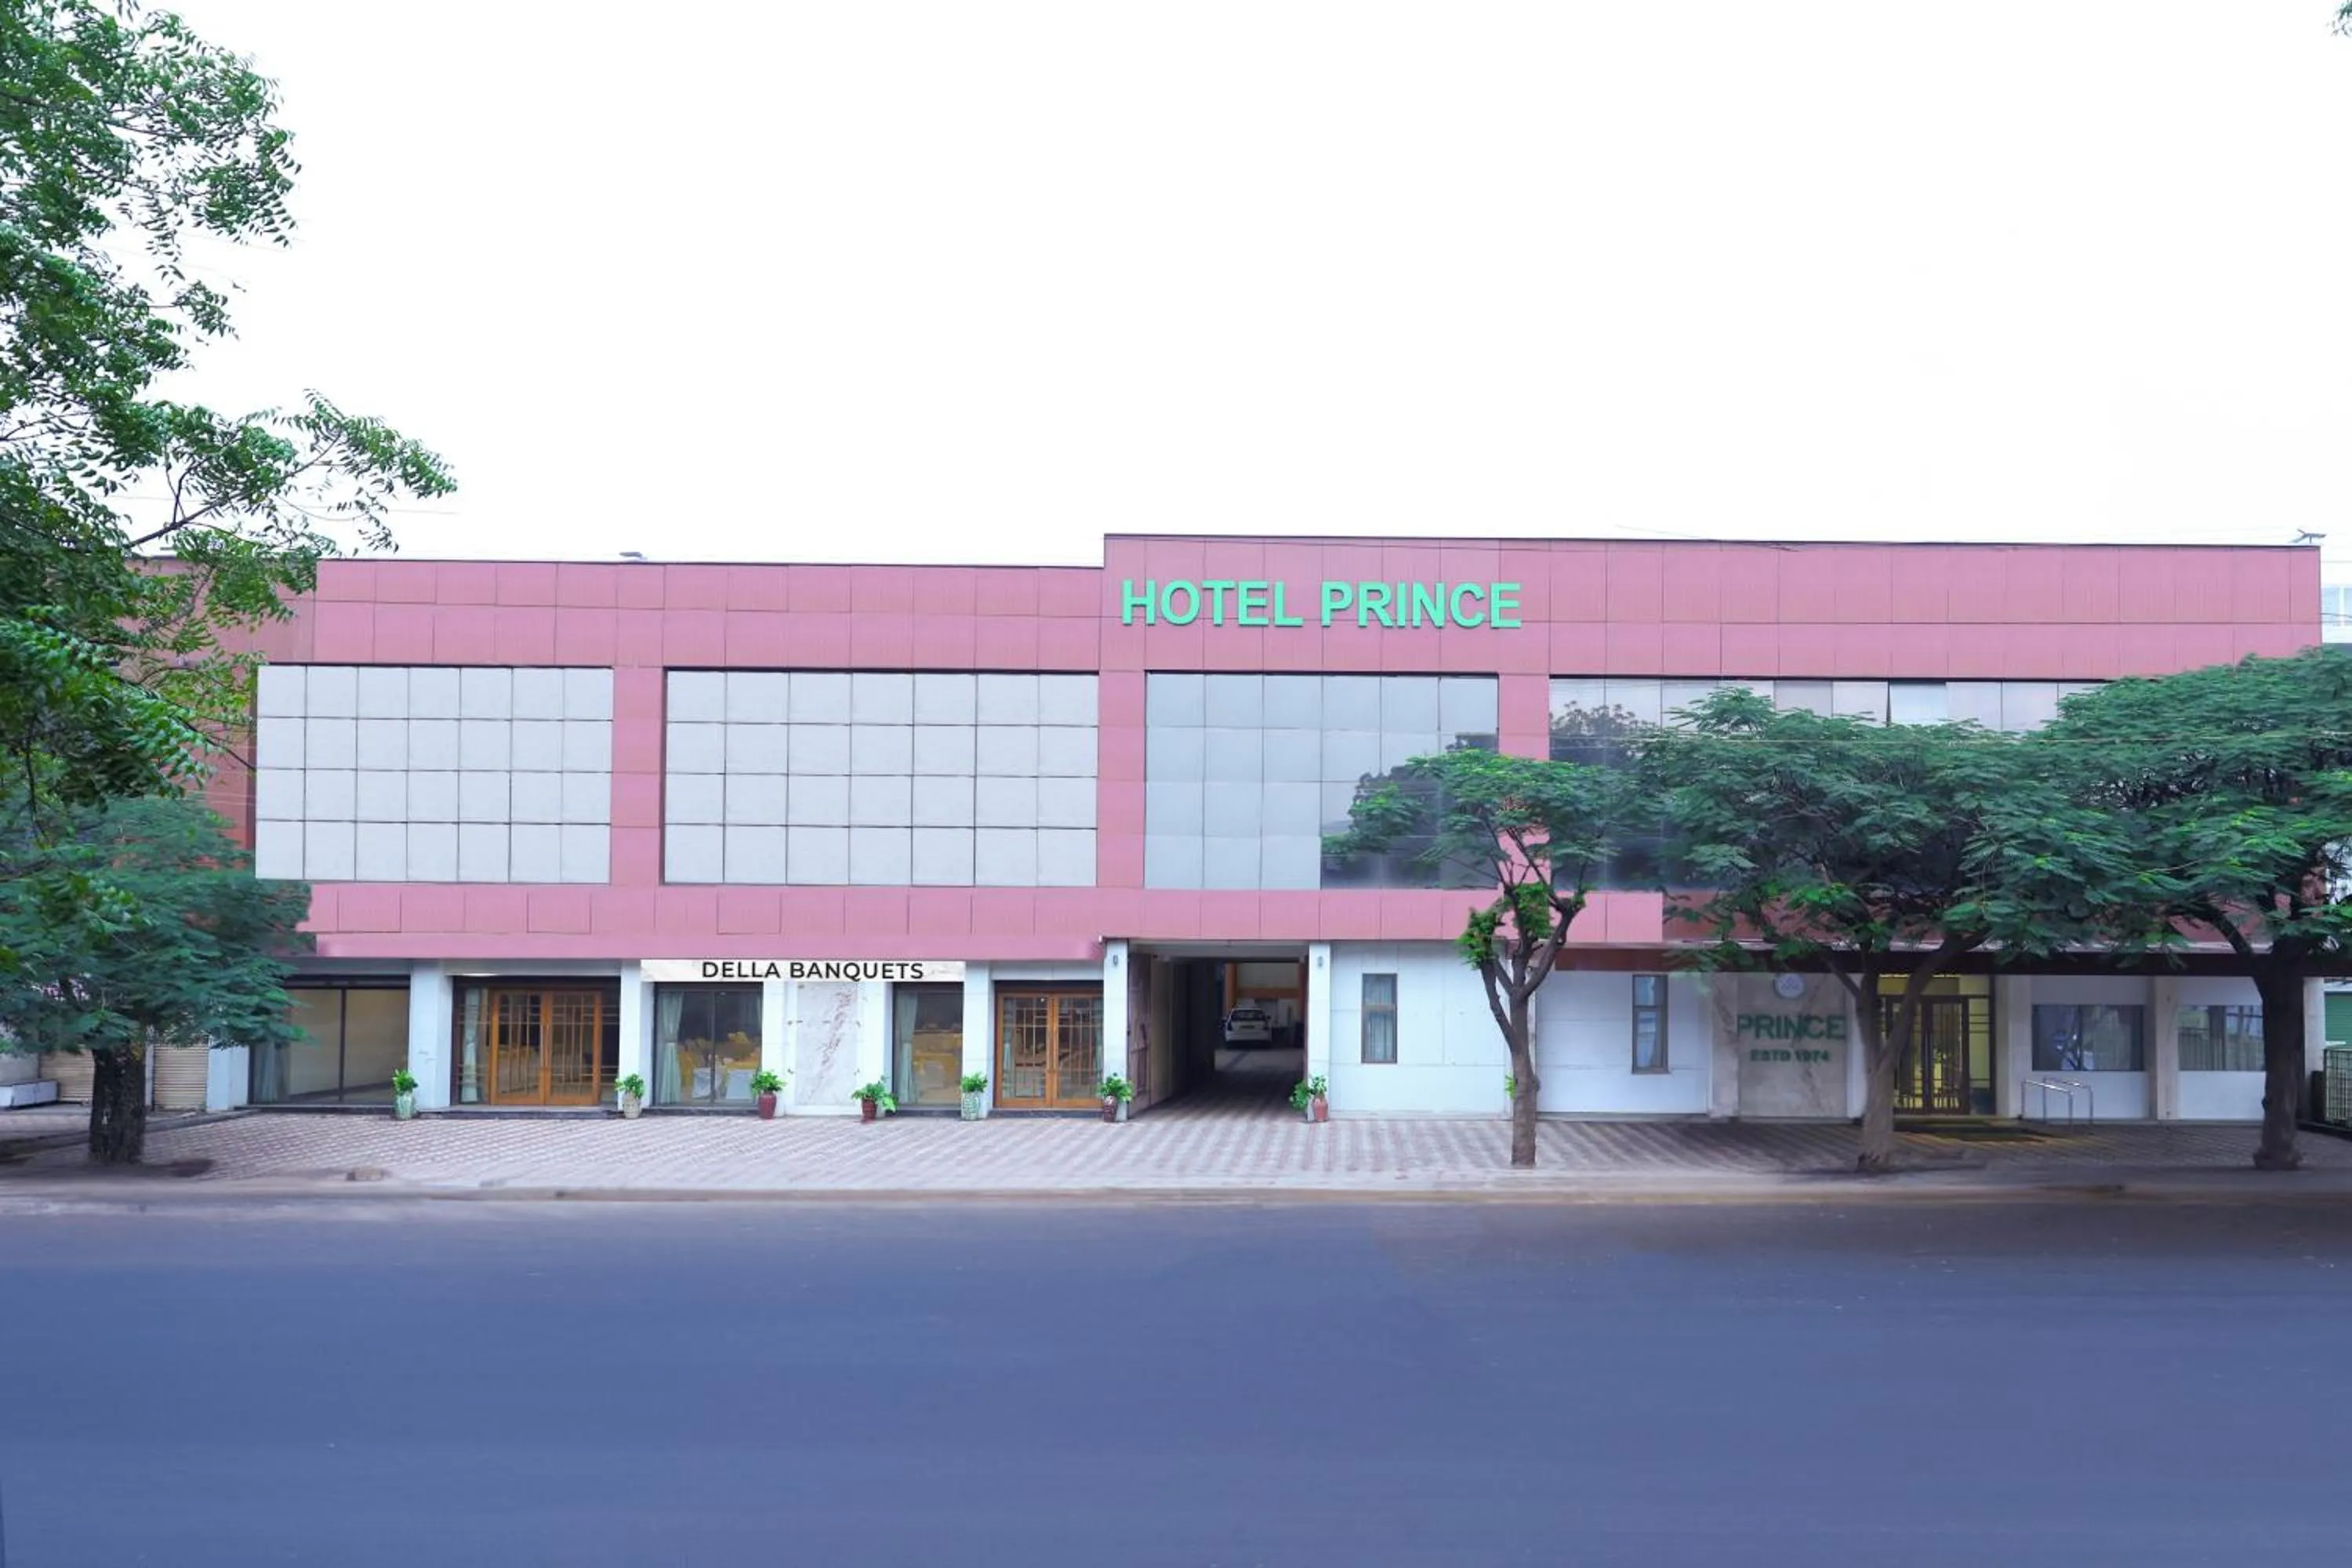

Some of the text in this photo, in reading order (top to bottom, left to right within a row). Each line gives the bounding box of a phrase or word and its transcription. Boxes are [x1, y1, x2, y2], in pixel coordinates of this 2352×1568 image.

[1121, 579, 1522, 629] HOTEL PRINCE
[702, 961, 924, 982] DELLA BANQUETS
[1737, 1014, 1846, 1040] PRINCE
